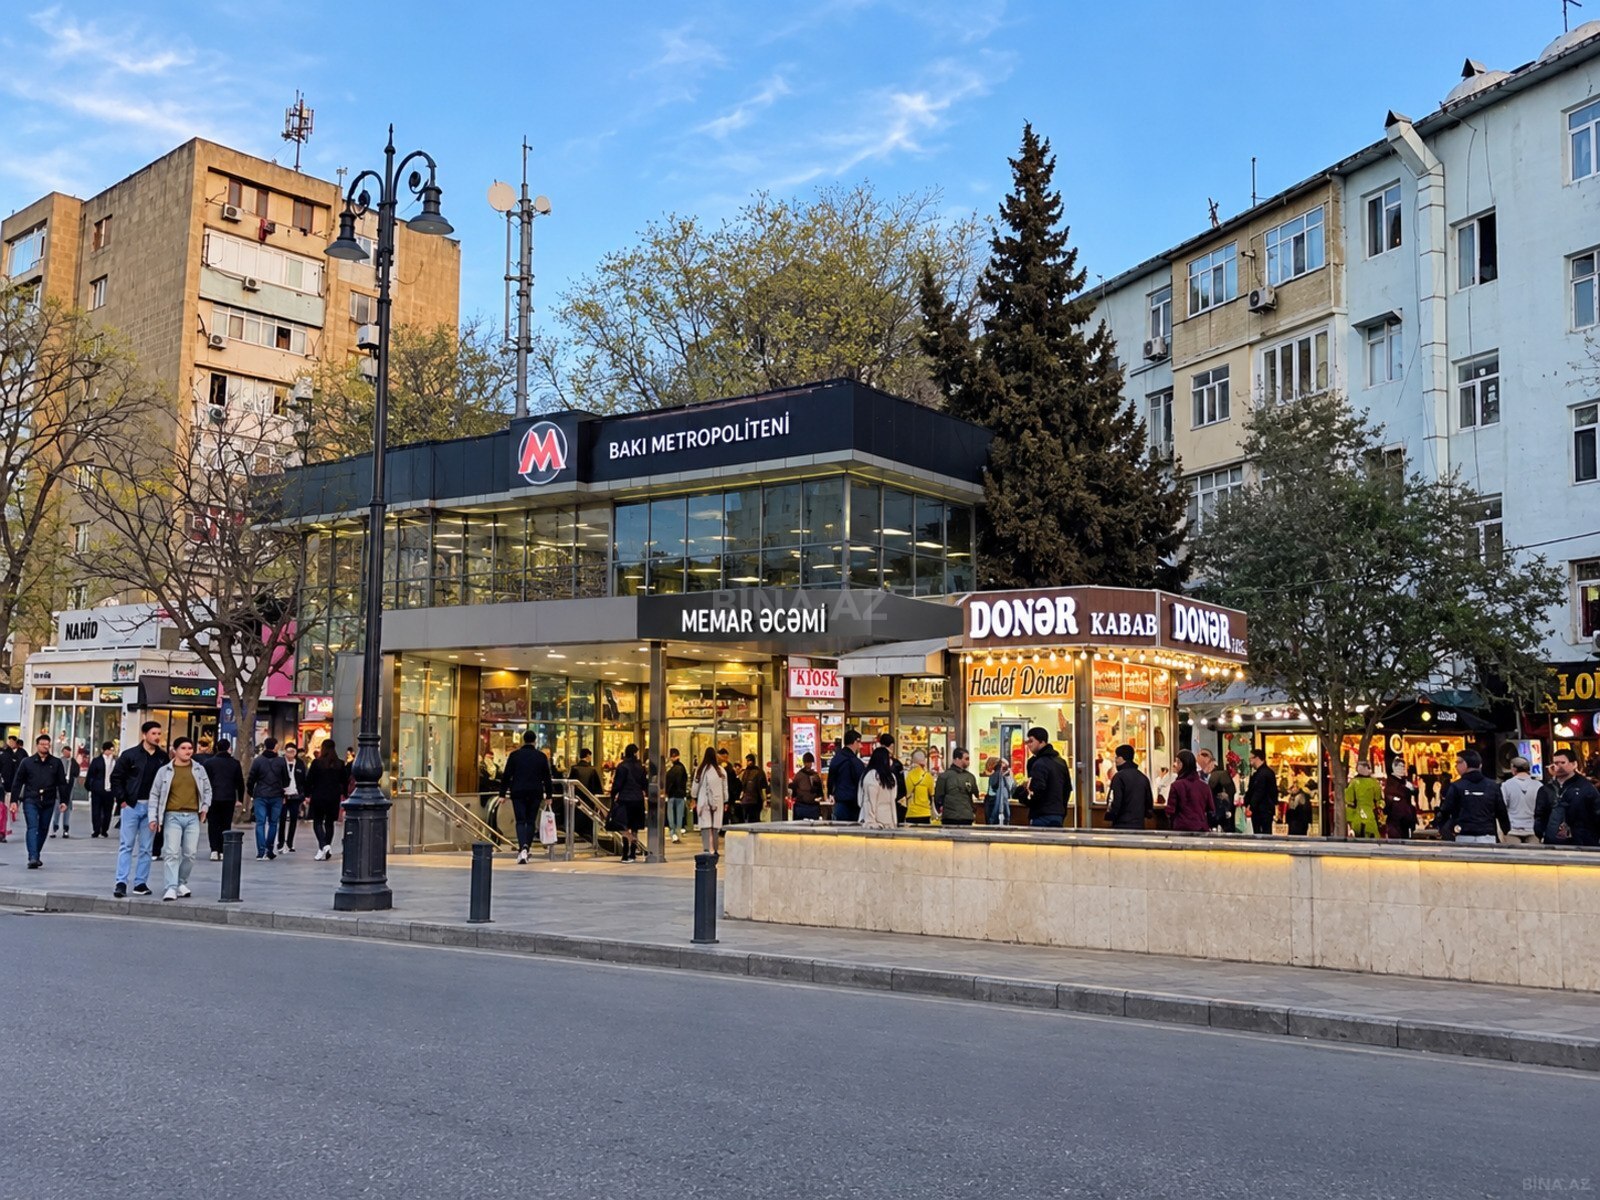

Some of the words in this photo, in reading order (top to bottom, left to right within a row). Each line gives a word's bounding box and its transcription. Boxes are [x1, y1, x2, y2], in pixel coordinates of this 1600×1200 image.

[518, 428, 567, 475] M
[609, 438, 647, 460] BAKI
[651, 411, 790, 453] METROPOLİTENİ
[65, 617, 98, 641] NAHİD
[681, 608, 753, 633] MEMAR
[759, 602, 826, 633] ƏCƏMİ
[969, 596, 1079, 639] DONƏR
[1090, 612, 1158, 636] KABAB
[1173, 602, 1231, 649] DONƏR
[796, 669, 840, 688] KIOSK
[970, 666, 1016, 696] Hadef
[1020, 664, 1075, 696] Döner
